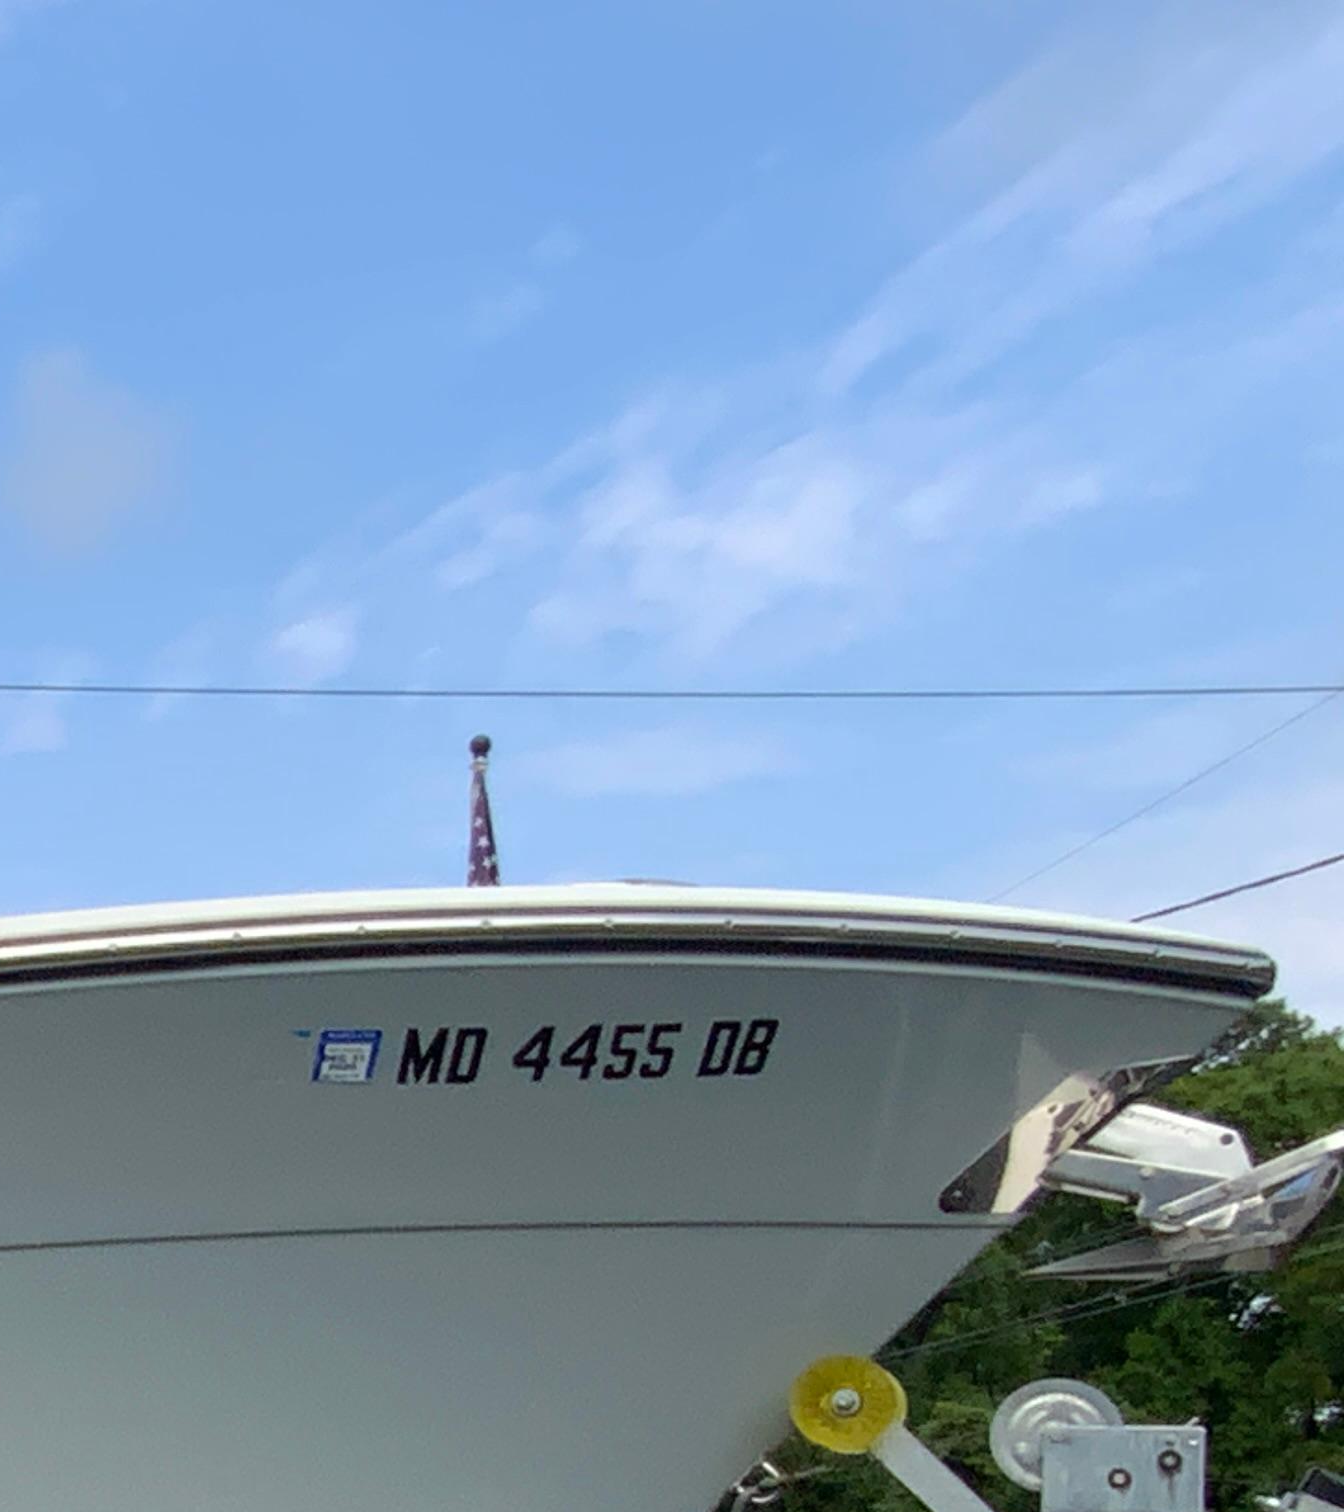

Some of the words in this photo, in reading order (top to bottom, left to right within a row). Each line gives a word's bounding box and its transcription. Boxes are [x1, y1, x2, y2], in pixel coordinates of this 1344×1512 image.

[397, 1026, 488, 1085] MD
[512, 1023, 683, 1082] 4455
[697, 1019, 779, 1078] DB
